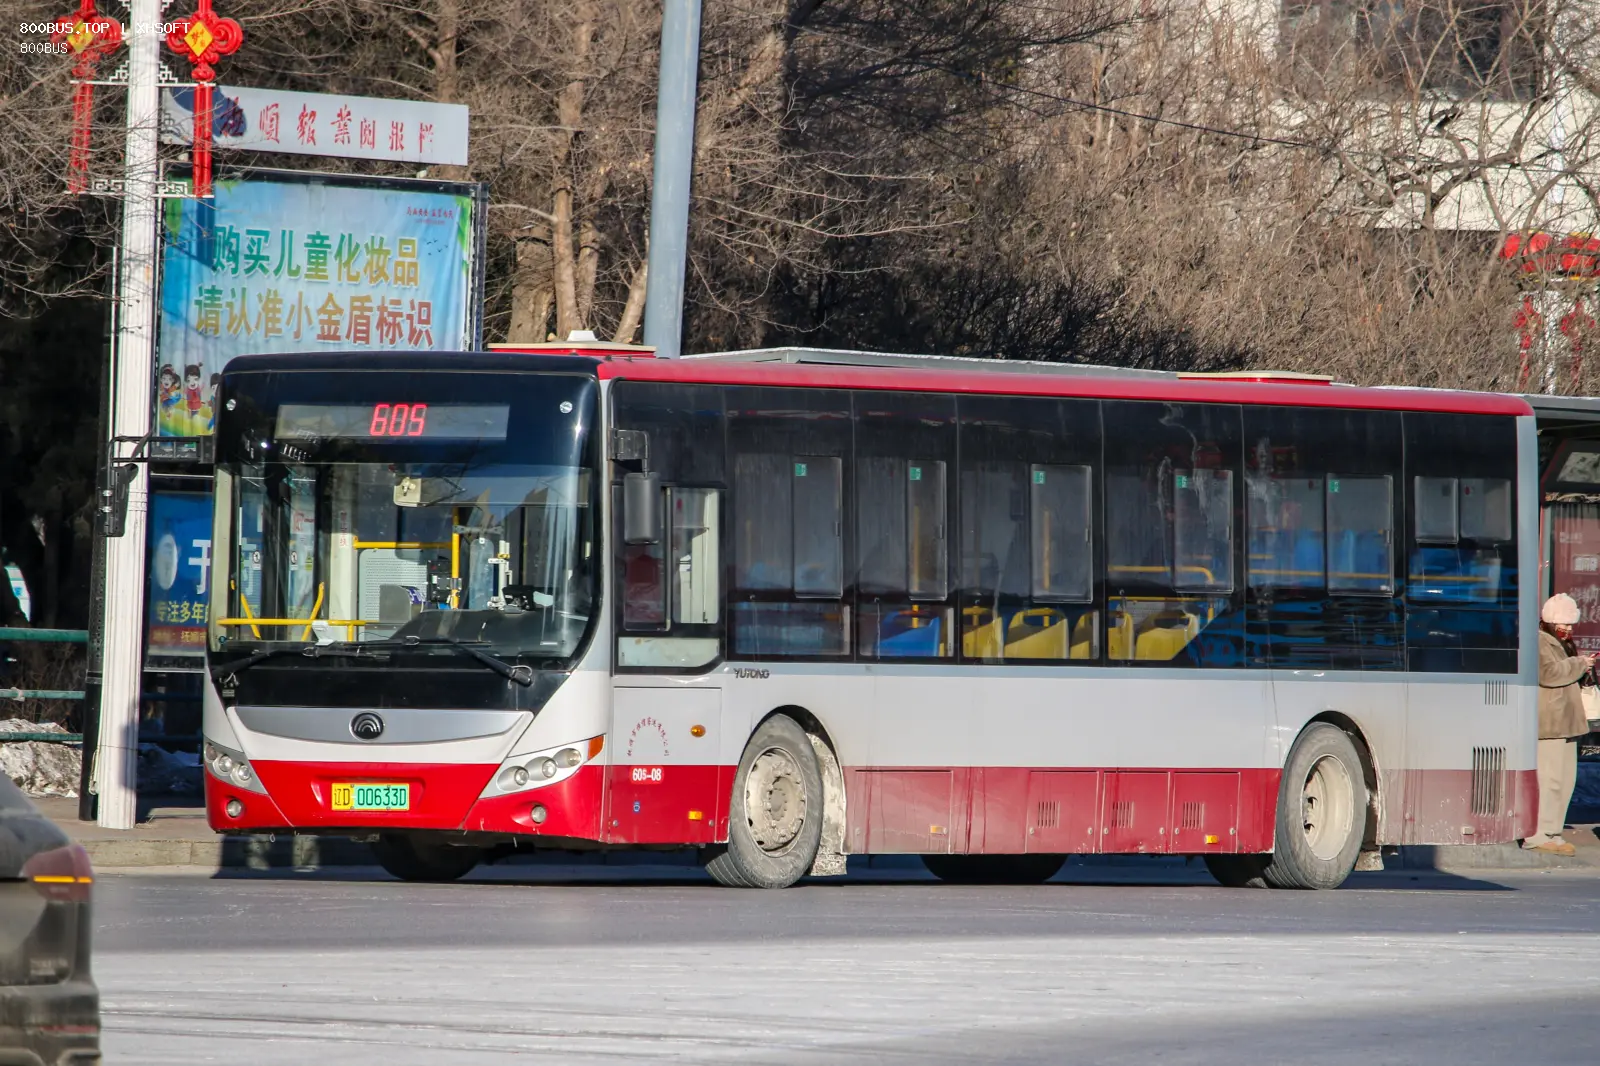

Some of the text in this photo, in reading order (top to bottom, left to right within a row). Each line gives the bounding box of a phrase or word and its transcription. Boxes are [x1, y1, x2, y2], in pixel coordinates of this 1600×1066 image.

[212, 225, 420, 287] 购买儿童化妆品
[194, 284, 434, 348] 请认准小金盾标识
[369, 404, 427, 436] 605
[733, 667, 771, 679] YUTONG
[632, 768, 662, 782] 605-08
[357, 788, 407, 806] 00633D
